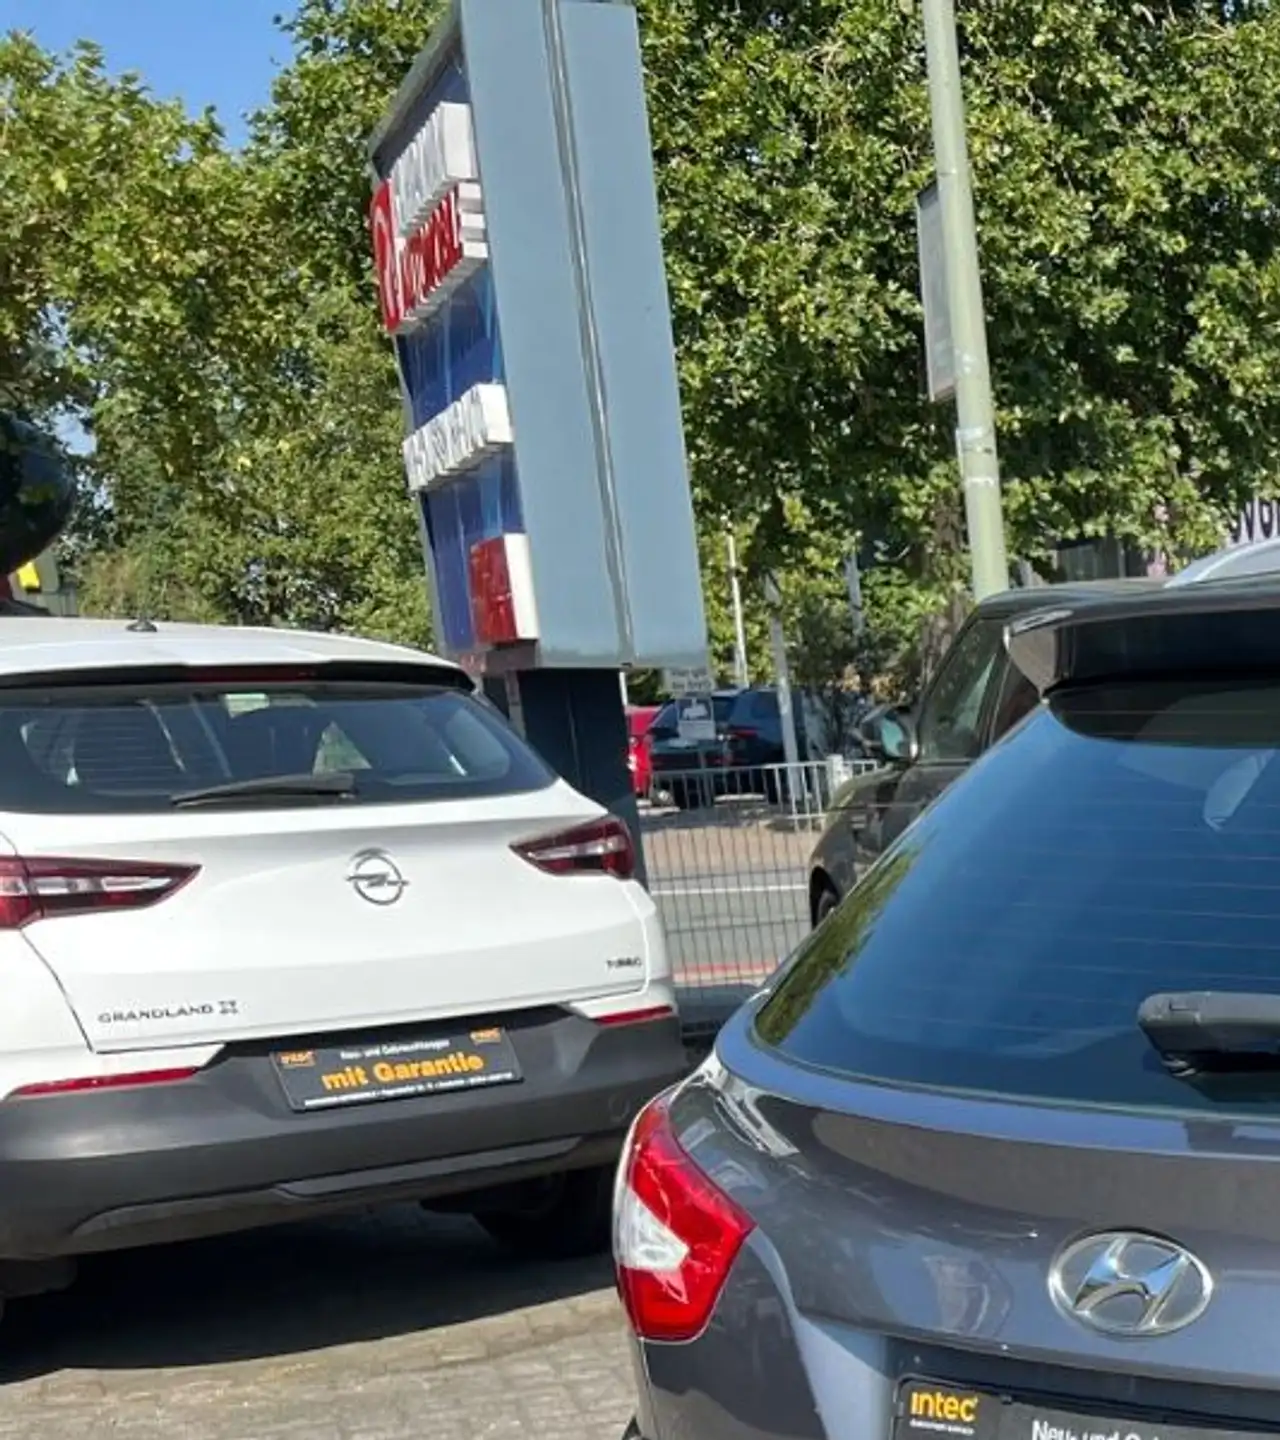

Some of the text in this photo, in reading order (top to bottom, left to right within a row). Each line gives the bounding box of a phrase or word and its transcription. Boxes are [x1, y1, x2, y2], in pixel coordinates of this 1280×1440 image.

[98, 1003, 214, 1023] GRANDLAND
[321, 1066, 369, 1091] mit
[373, 1051, 485, 1083] Garantie
